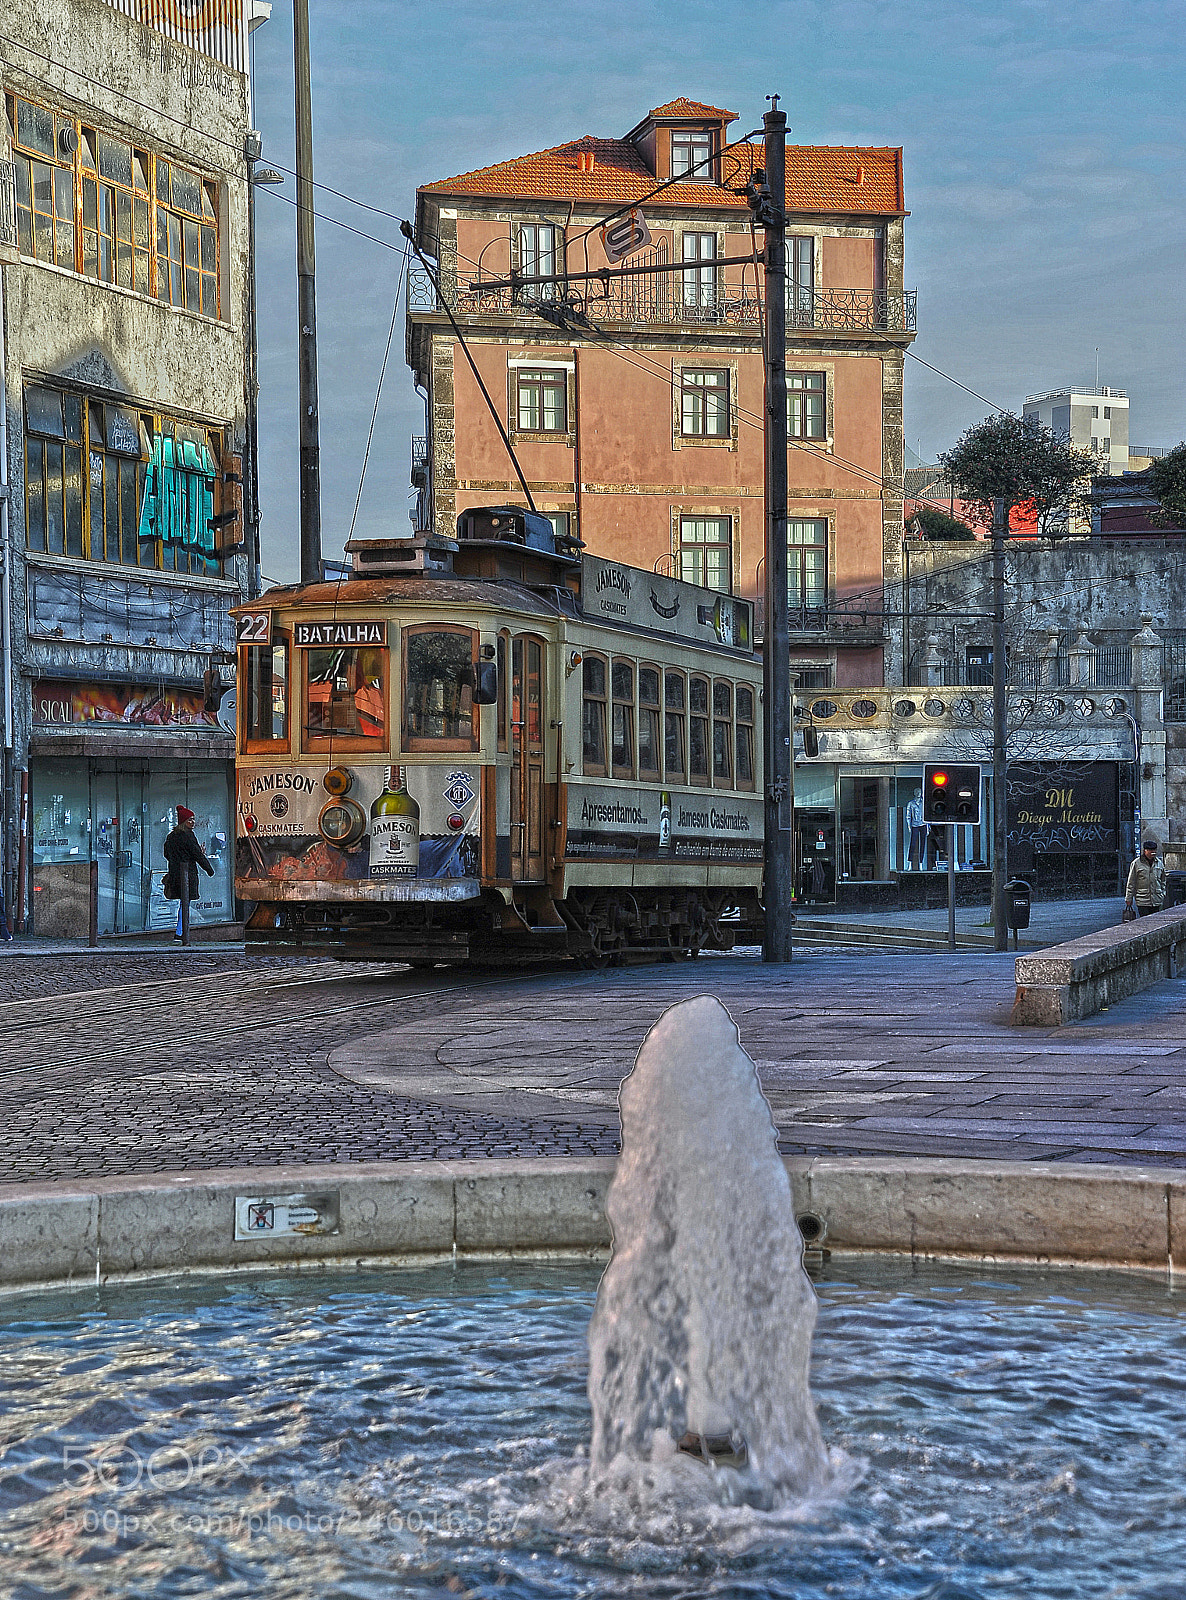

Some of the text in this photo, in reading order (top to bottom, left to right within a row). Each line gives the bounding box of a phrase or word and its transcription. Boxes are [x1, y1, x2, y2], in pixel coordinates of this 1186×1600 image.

[595, 568, 631, 600] JAMESON
[239, 615, 268, 640] 22
[298, 625, 382, 643] BATALHA
[40, 699, 71, 723] SICAL
[249, 773, 316, 797] JAMESON
[238, 801, 254, 814] 131
[1044, 788, 1076, 808] DM
[580, 797, 648, 827] Apresentamos...
[677, 805, 709, 828] Jameson
[1017, 810, 1102, 828] Diego Martin
[258, 823, 305, 833] CASKMATES
[371, 866, 417, 874] CASKMATES
